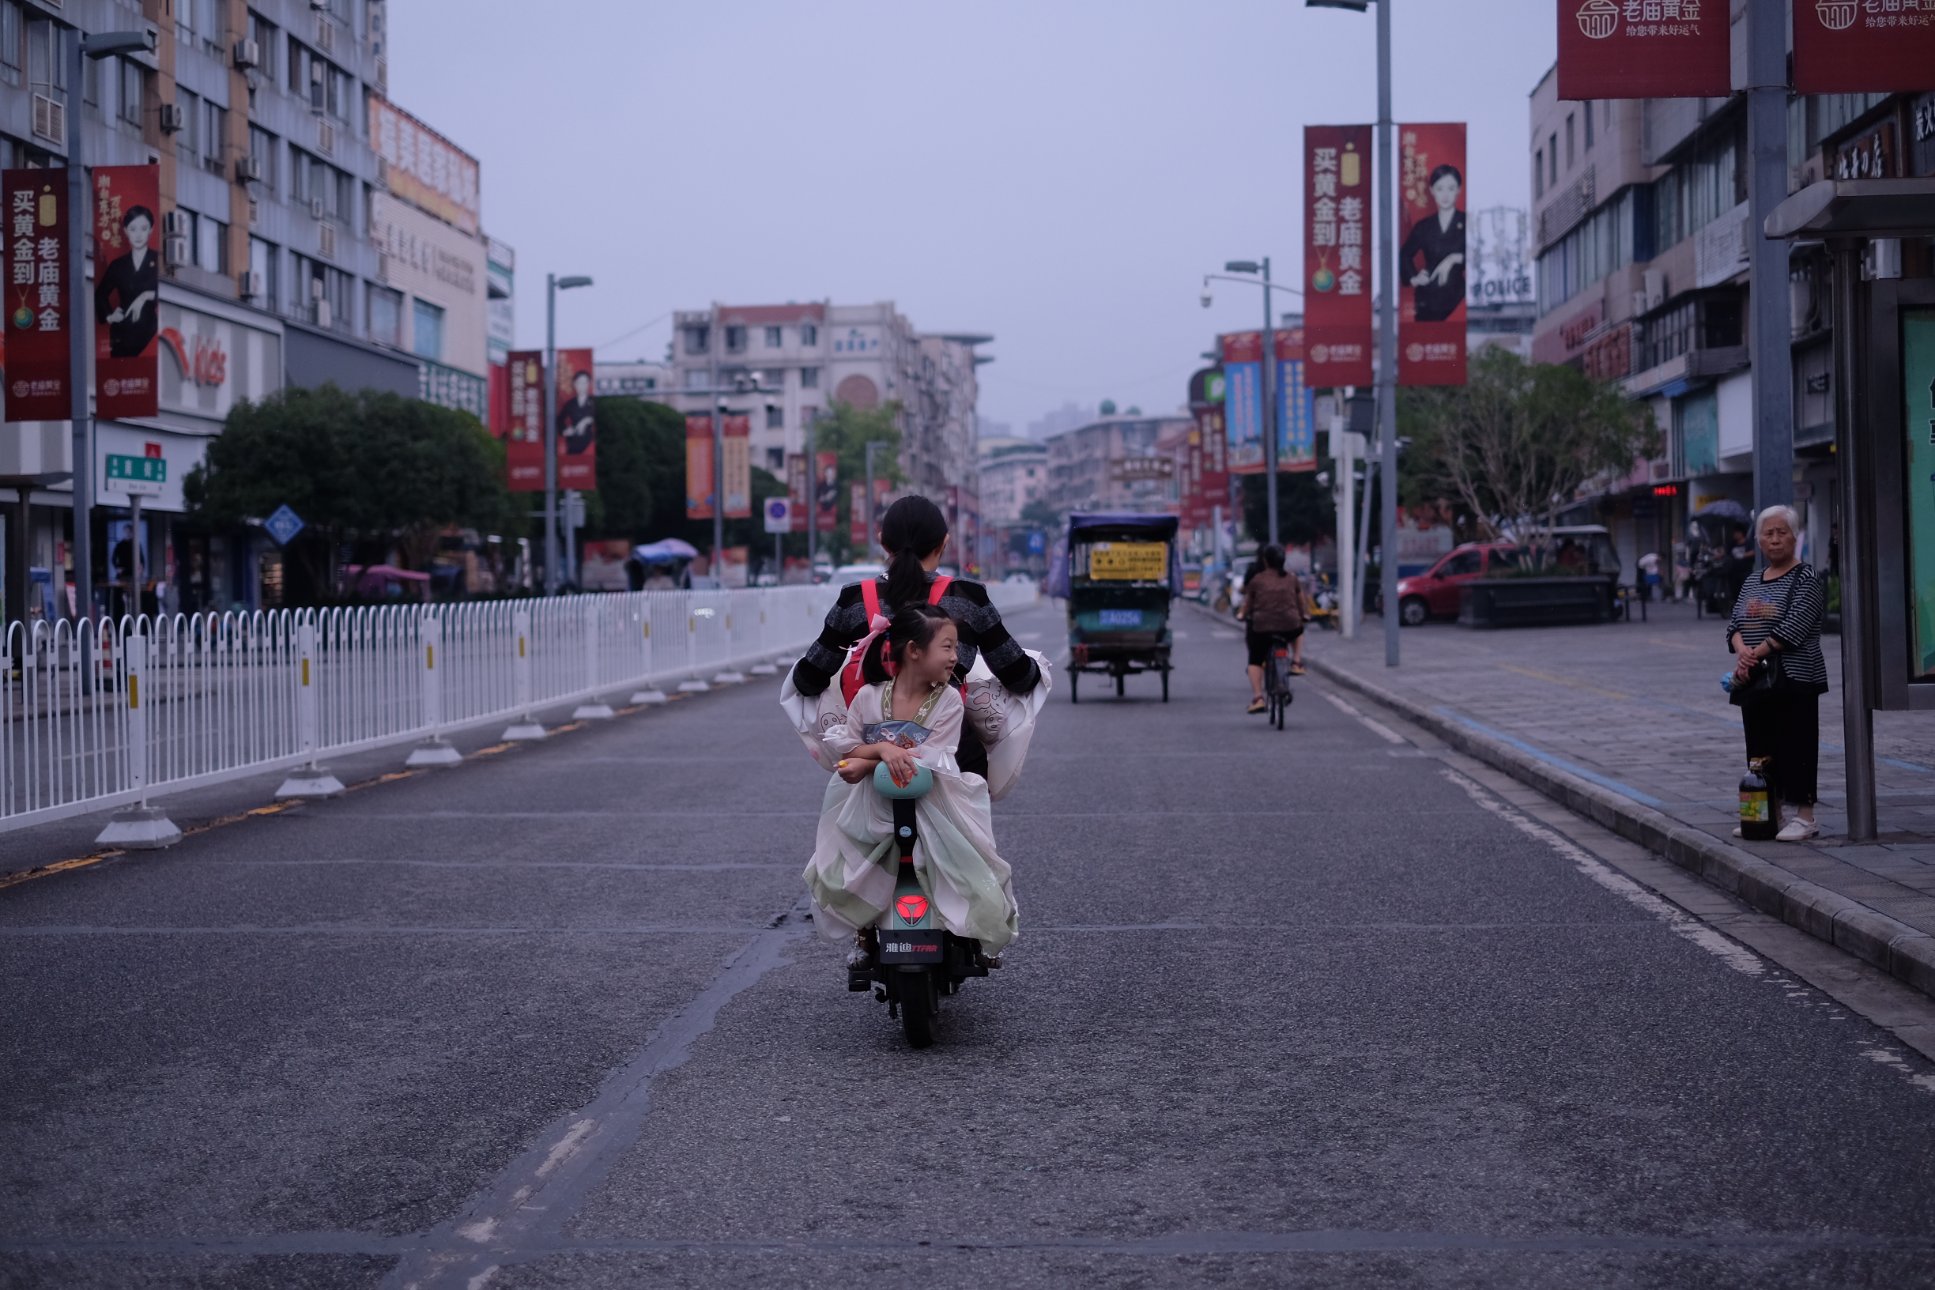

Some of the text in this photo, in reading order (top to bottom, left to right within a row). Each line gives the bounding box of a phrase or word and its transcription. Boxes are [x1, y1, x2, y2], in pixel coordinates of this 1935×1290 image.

[1622, 0, 1701, 22] 老庙黄金
[1626, 23, 1700, 37] 给您带来好运气
[1915, 97, 1935, 141] 炭火
[1313, 148, 1337, 246] 买黄金到
[13, 190, 35, 284] 买黄金到
[1339, 197, 1363, 295] 老庙黄金
[38, 237, 60, 331] 老庙黄金
[1472, 277, 1531, 297] POLICE
[885, 942, 912, 953] 雅迪
